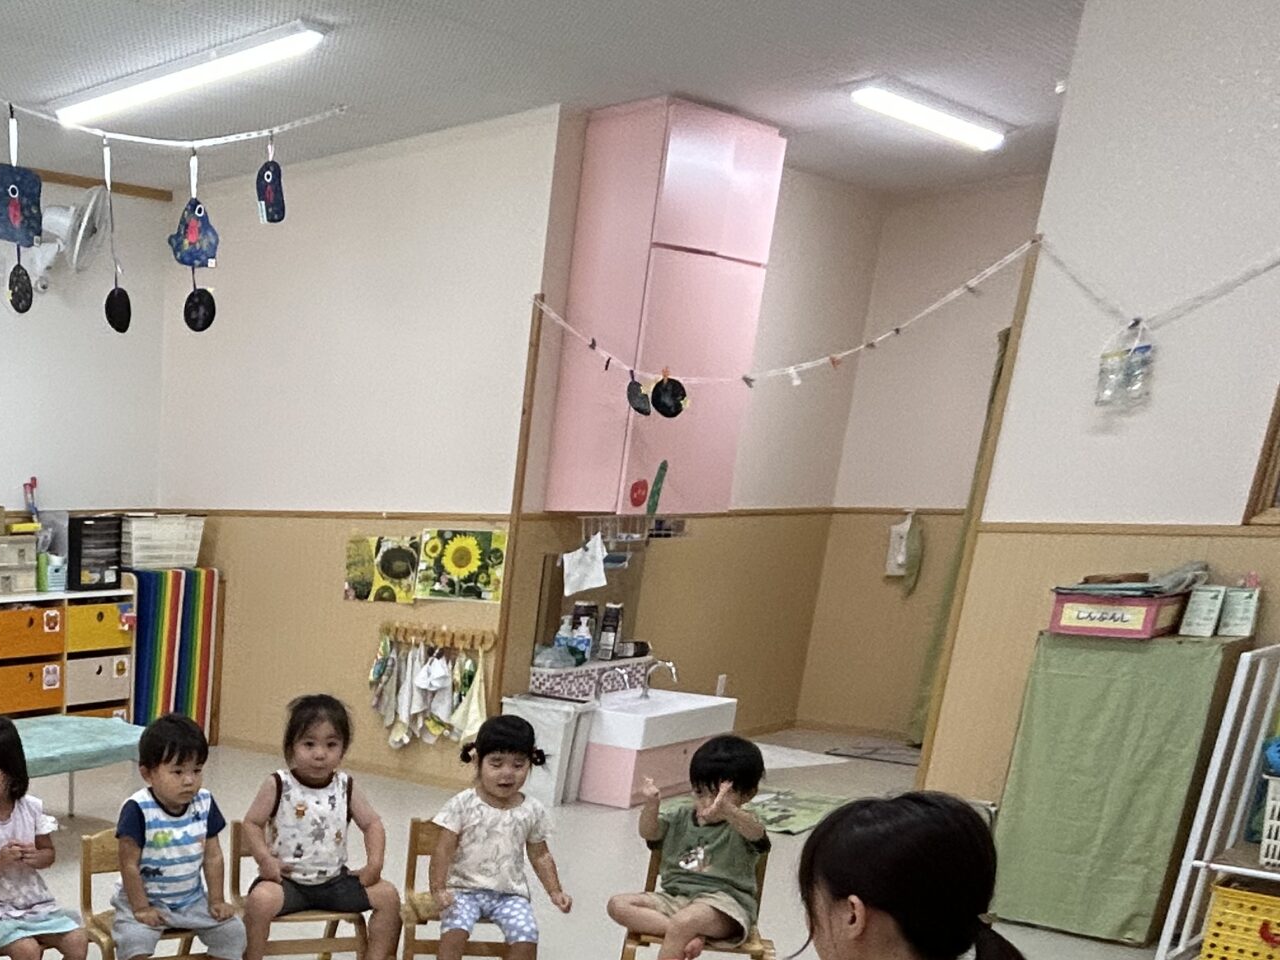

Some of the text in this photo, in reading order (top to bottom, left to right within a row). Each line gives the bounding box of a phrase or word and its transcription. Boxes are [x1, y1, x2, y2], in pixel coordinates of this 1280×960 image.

[1075, 609, 1130, 624] しんぶんし
